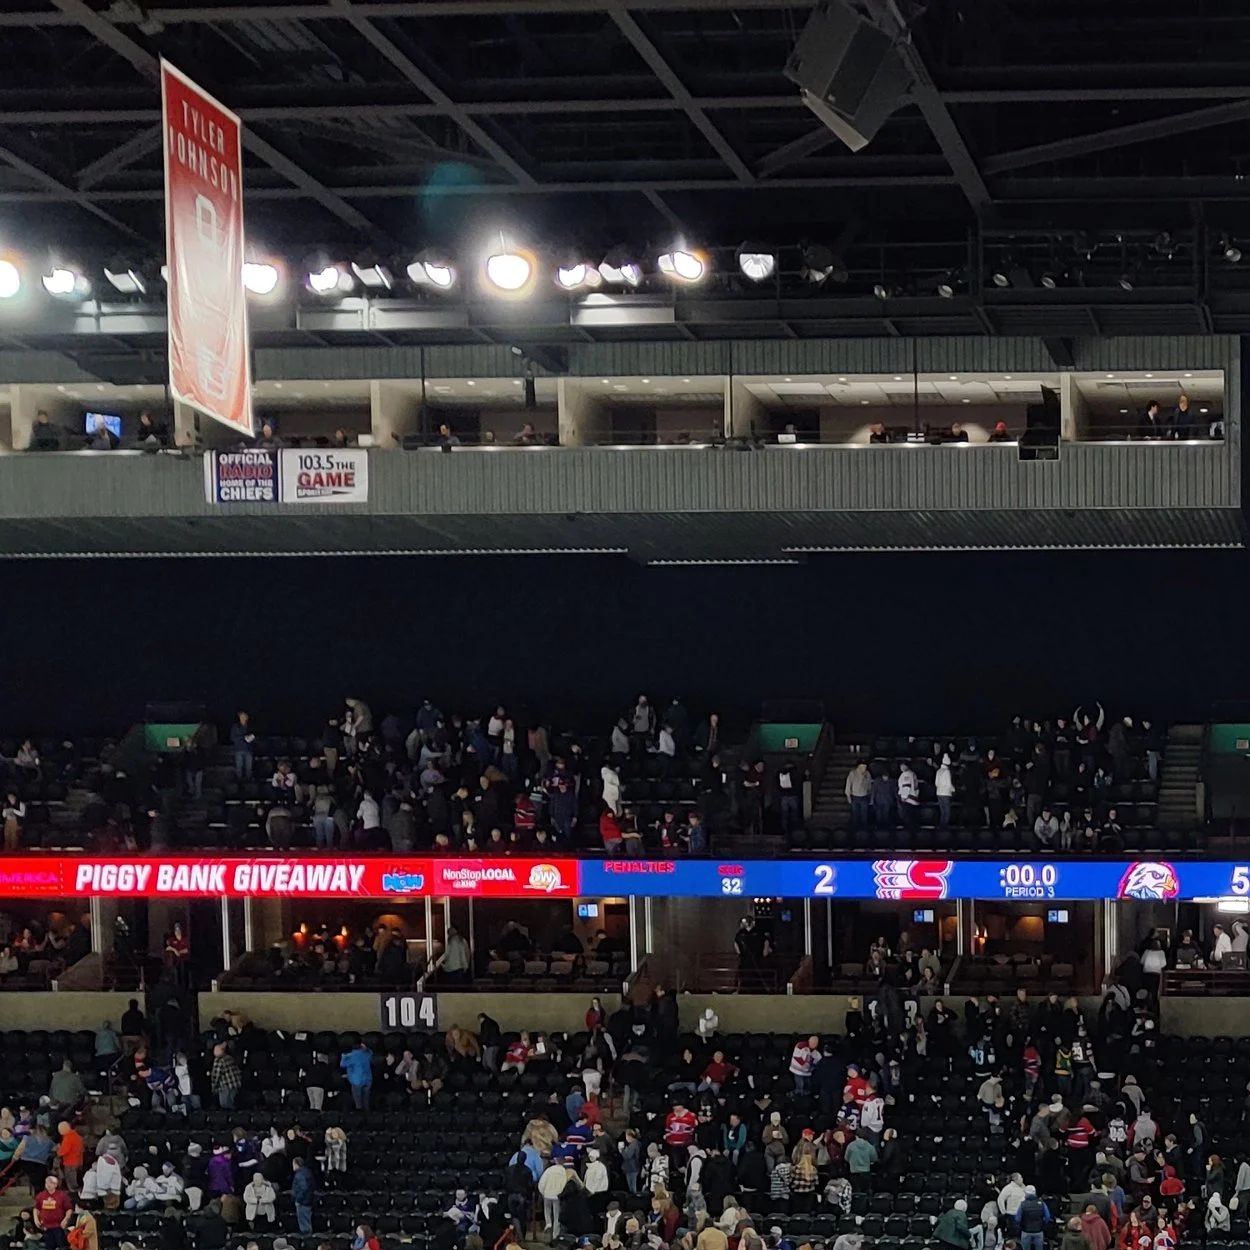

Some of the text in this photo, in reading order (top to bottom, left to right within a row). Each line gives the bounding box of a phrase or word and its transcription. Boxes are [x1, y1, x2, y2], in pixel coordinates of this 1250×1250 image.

[182, 100, 225, 156] TYLER
[219, 453, 273, 465] OFFICIAL
[298, 455, 355, 470] 103.5 THE
[219, 465, 273, 479] RADIO
[297, 472, 356, 488] GAME
[220, 488, 274, 501] CHIEFS
[604, 861, 675, 873] PENALTIES
[1000, 864, 1056, 886] :00.0
[76, 864, 365, 892] PIGGY BANK GIVEAWAY
[721, 877, 743, 894] 32
[813, 864, 835, 895] 2
[1231, 866, 1249, 895] 5
[1005, 886, 1055, 898] PERIOD 3
[385, 997, 435, 1027] 104
